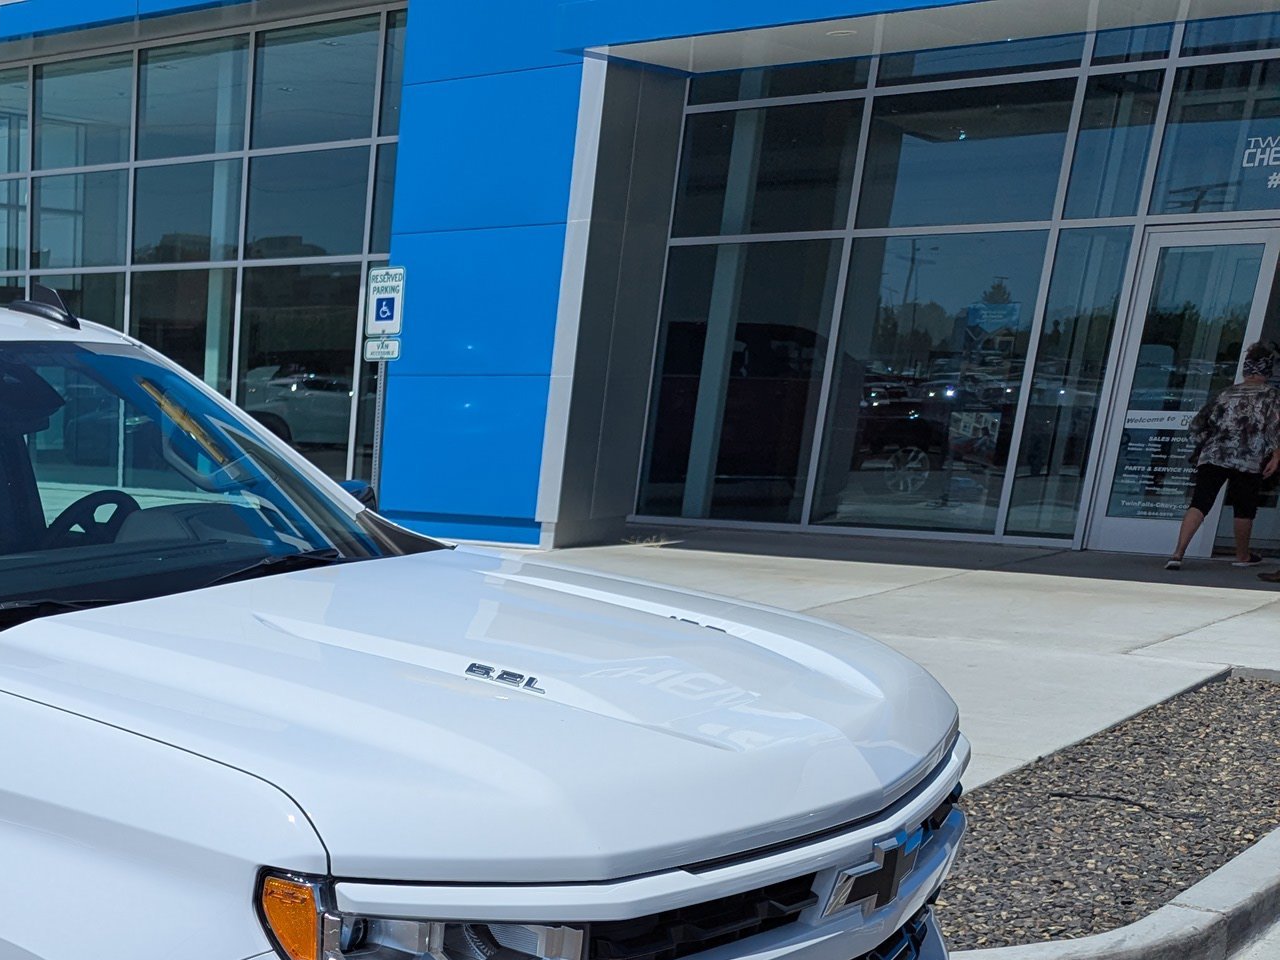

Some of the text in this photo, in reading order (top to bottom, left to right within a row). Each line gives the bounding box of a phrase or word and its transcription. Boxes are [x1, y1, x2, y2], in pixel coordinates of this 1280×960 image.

[1247, 136, 1280, 149] TW
[371, 273, 403, 283] RESERVED
[372, 285, 400, 295] PARKING
[1126, 416, 1165, 424] Welcome
[465, 662, 546, 694] 6.2L
